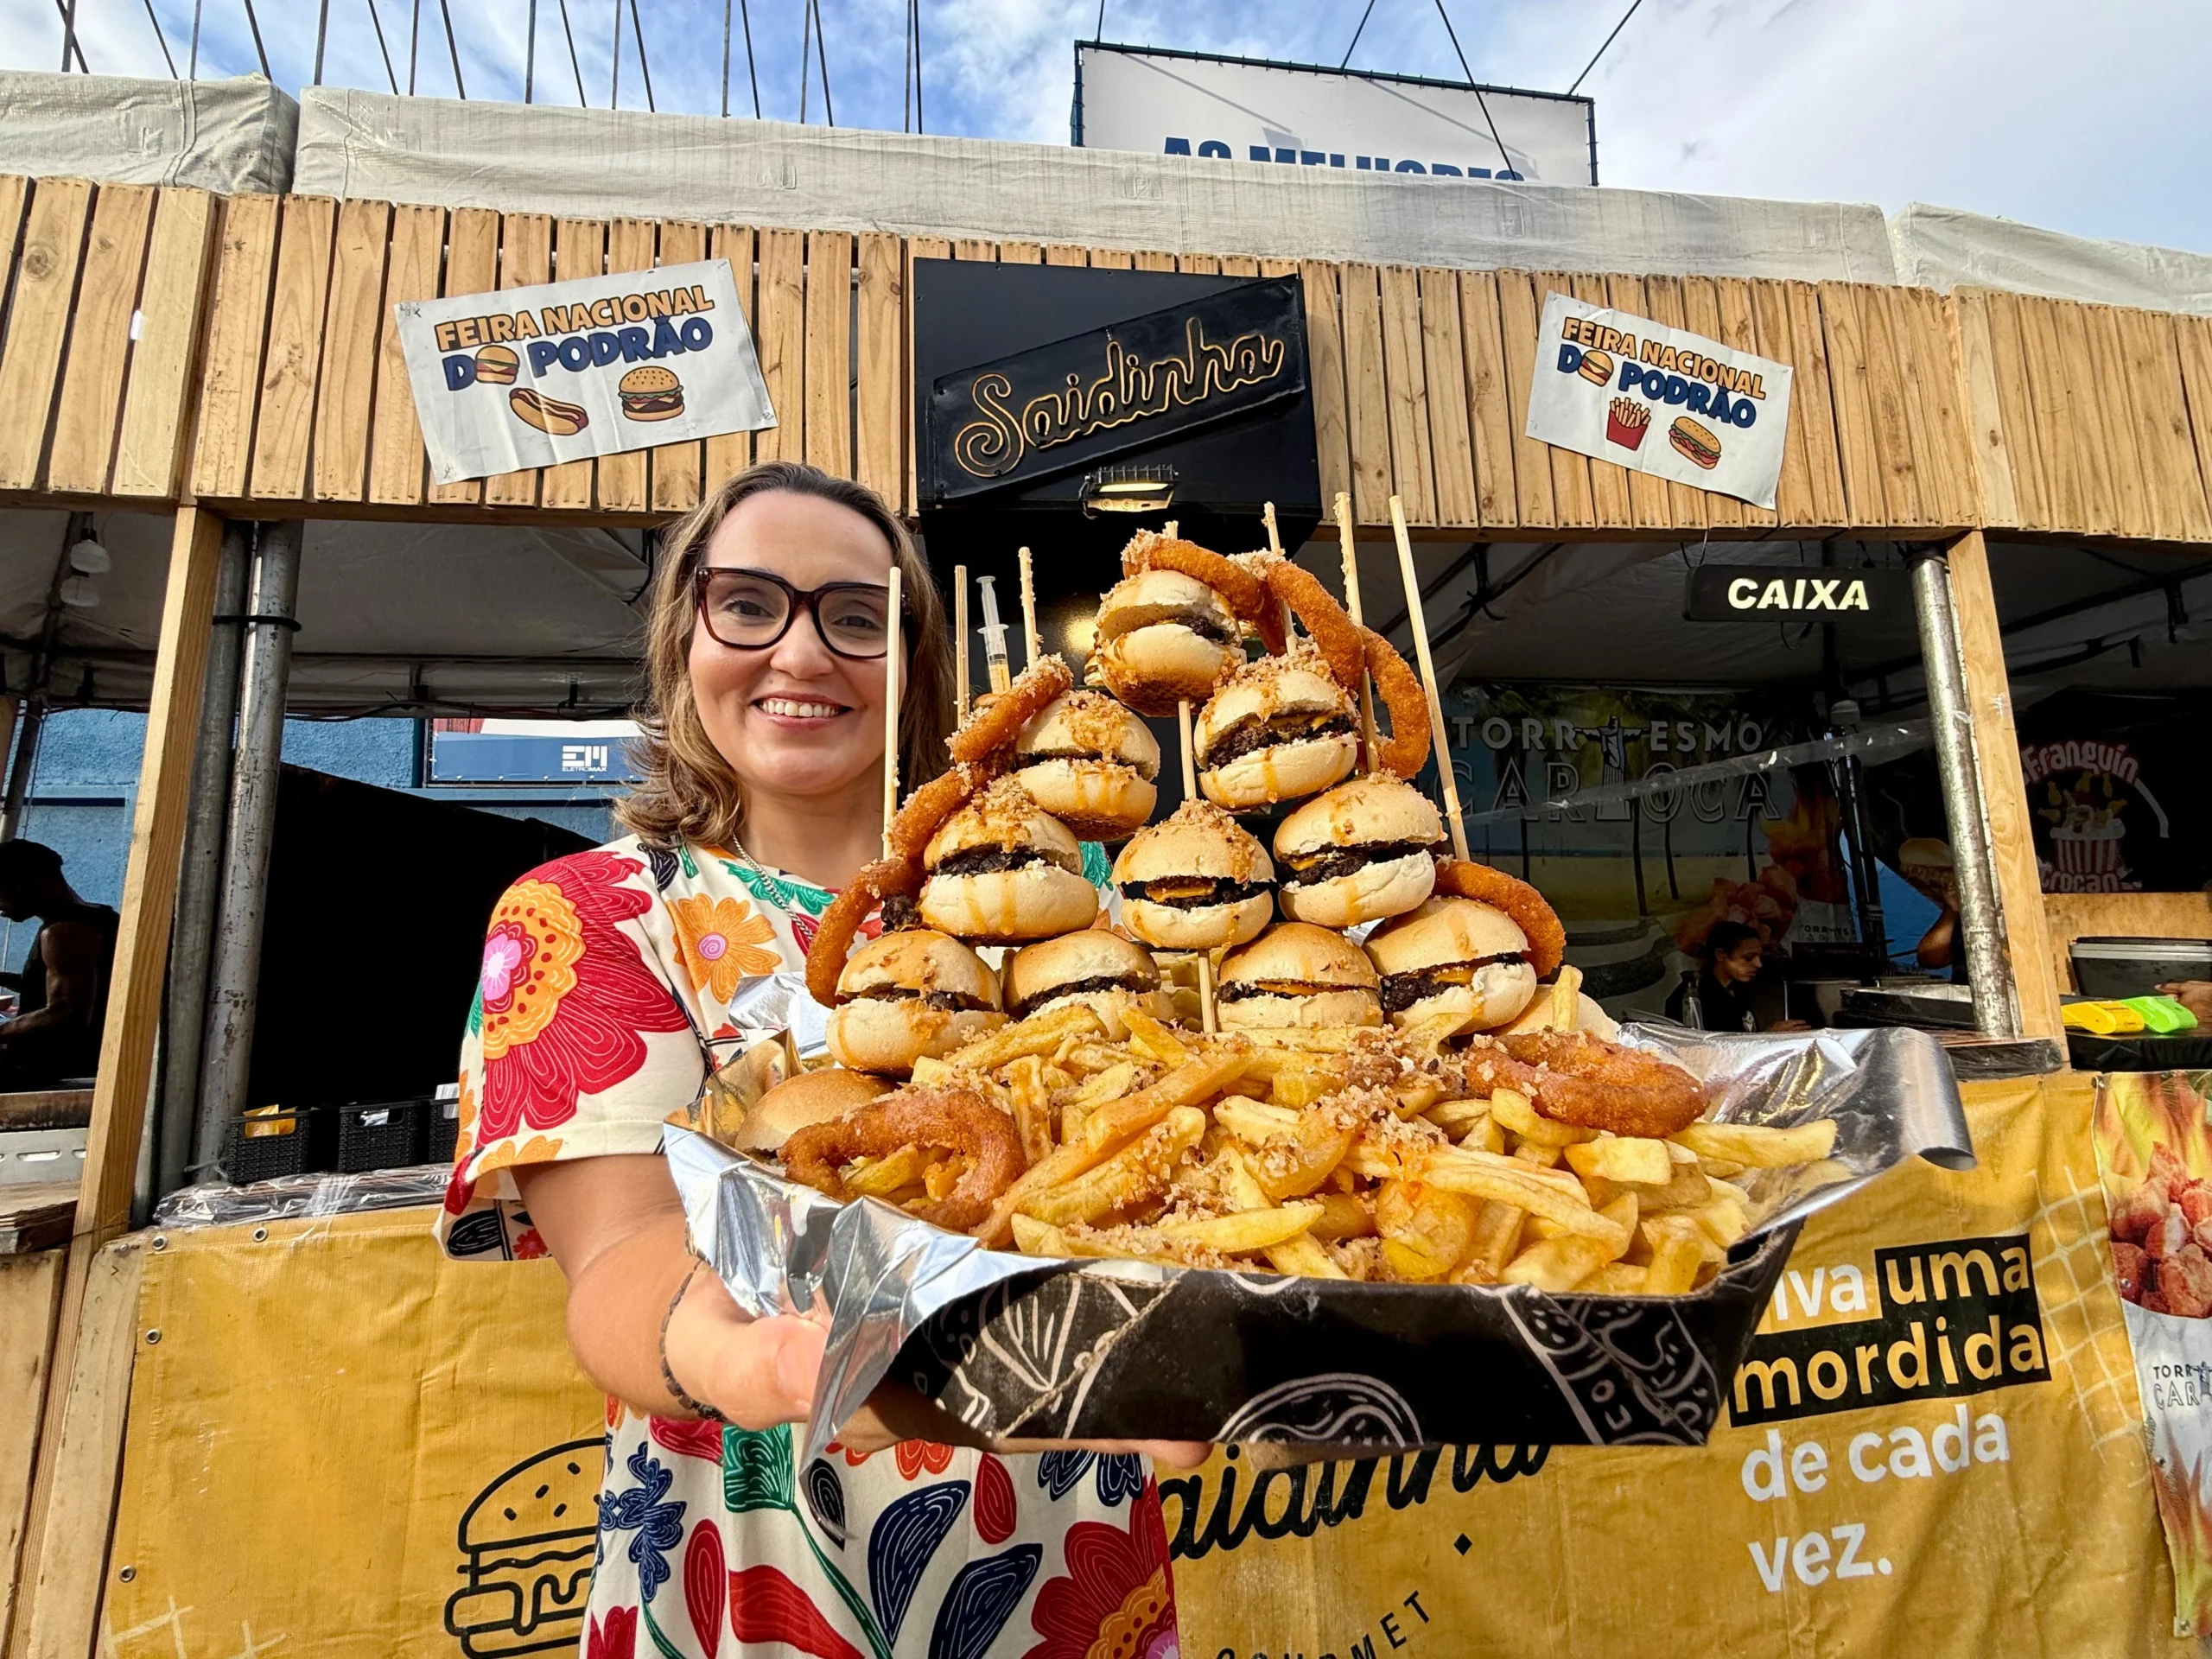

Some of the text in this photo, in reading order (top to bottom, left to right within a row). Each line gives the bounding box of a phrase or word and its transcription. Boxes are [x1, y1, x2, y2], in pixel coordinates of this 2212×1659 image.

[435, 285, 715, 352] FEIRA NACIONAL
[527, 316, 713, 378] PODRÃO
[1562, 316, 1766, 400] FEIRA NACIONAL
[954, 317, 1285, 477] Saidinha
[1618, 361, 1757, 429] PODRÃO
[1727, 578, 1870, 611] CAIXA
[1884, 1246, 2030, 1306] uma
[1735, 1314, 2045, 1414] mordida
[2153, 1364, 2192, 1379] TORR
[1741, 1403, 2010, 1502] de cada
[1748, 1522, 1892, 1592] vez.
